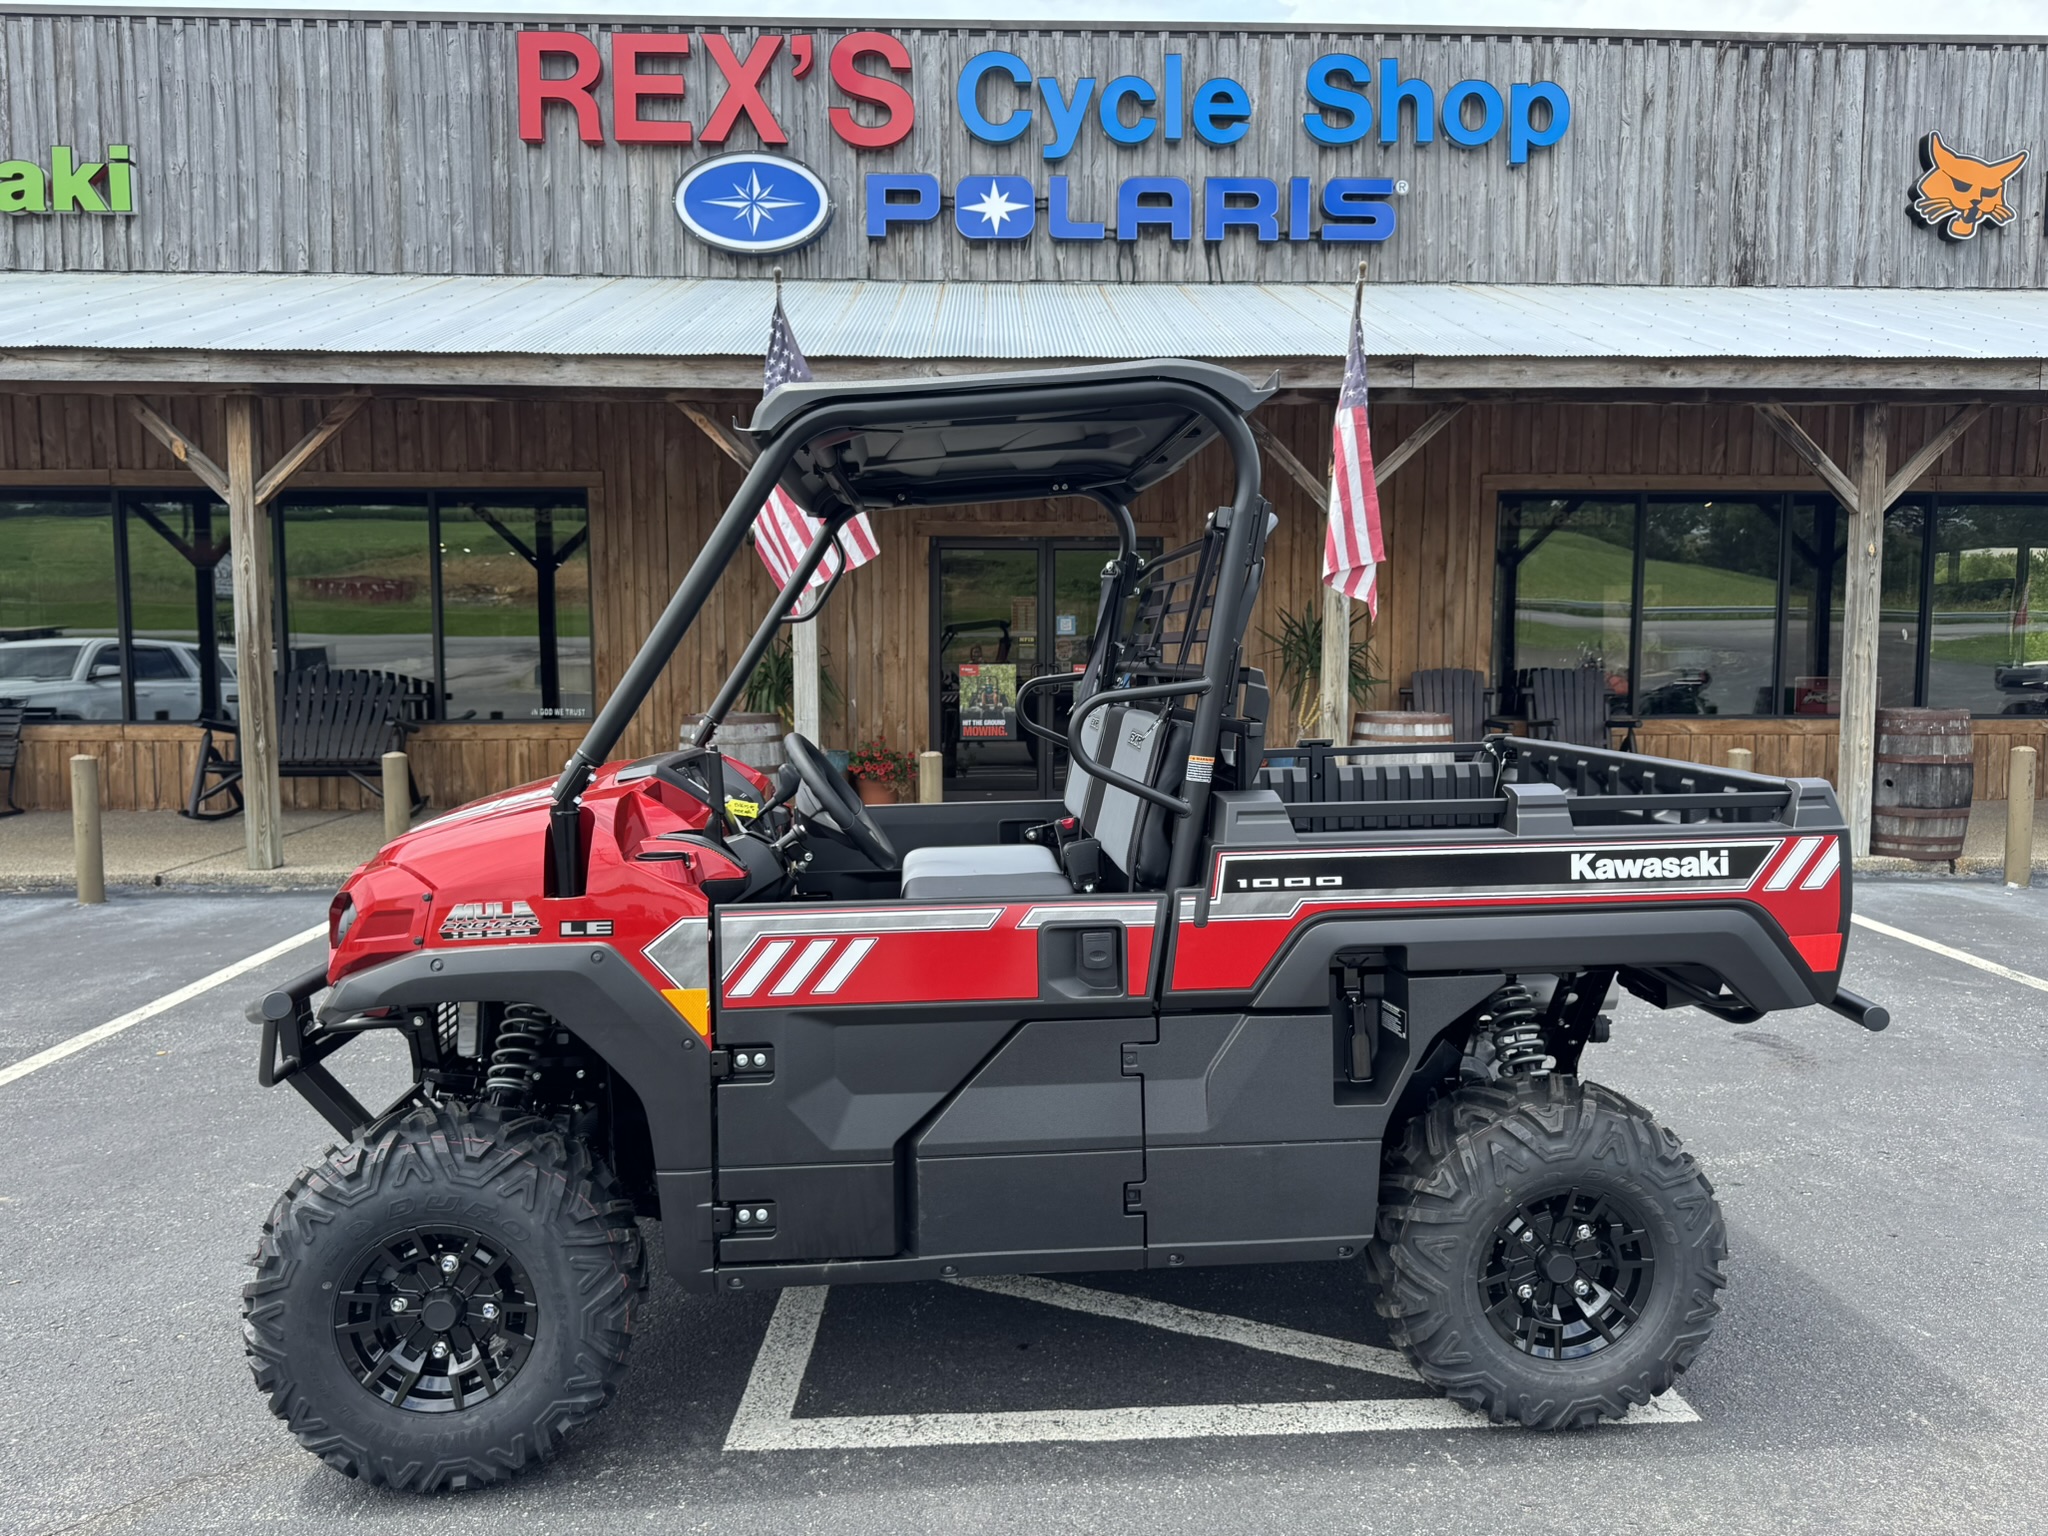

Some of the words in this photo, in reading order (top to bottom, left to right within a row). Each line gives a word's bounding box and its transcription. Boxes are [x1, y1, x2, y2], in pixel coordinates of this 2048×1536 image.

[517, 31, 916, 149] REX'S
[957, 51, 1252, 160] Cycle
[1303, 53, 1570, 165] Shop
[866, 173, 1396, 241] POLARIS
[540, 708, 553, 716] GOD
[554, 708, 564, 716] WE
[565, 708, 586, 716] TRUST
[963, 726, 1008, 737] MOWING.
[1570, 850, 1729, 880] Kawasaki
[1237, 876, 1342, 888] 1000
[444, 901, 538, 922] MULE
[560, 921, 612, 935] LE
[387, 1195, 531, 1242] DURO
